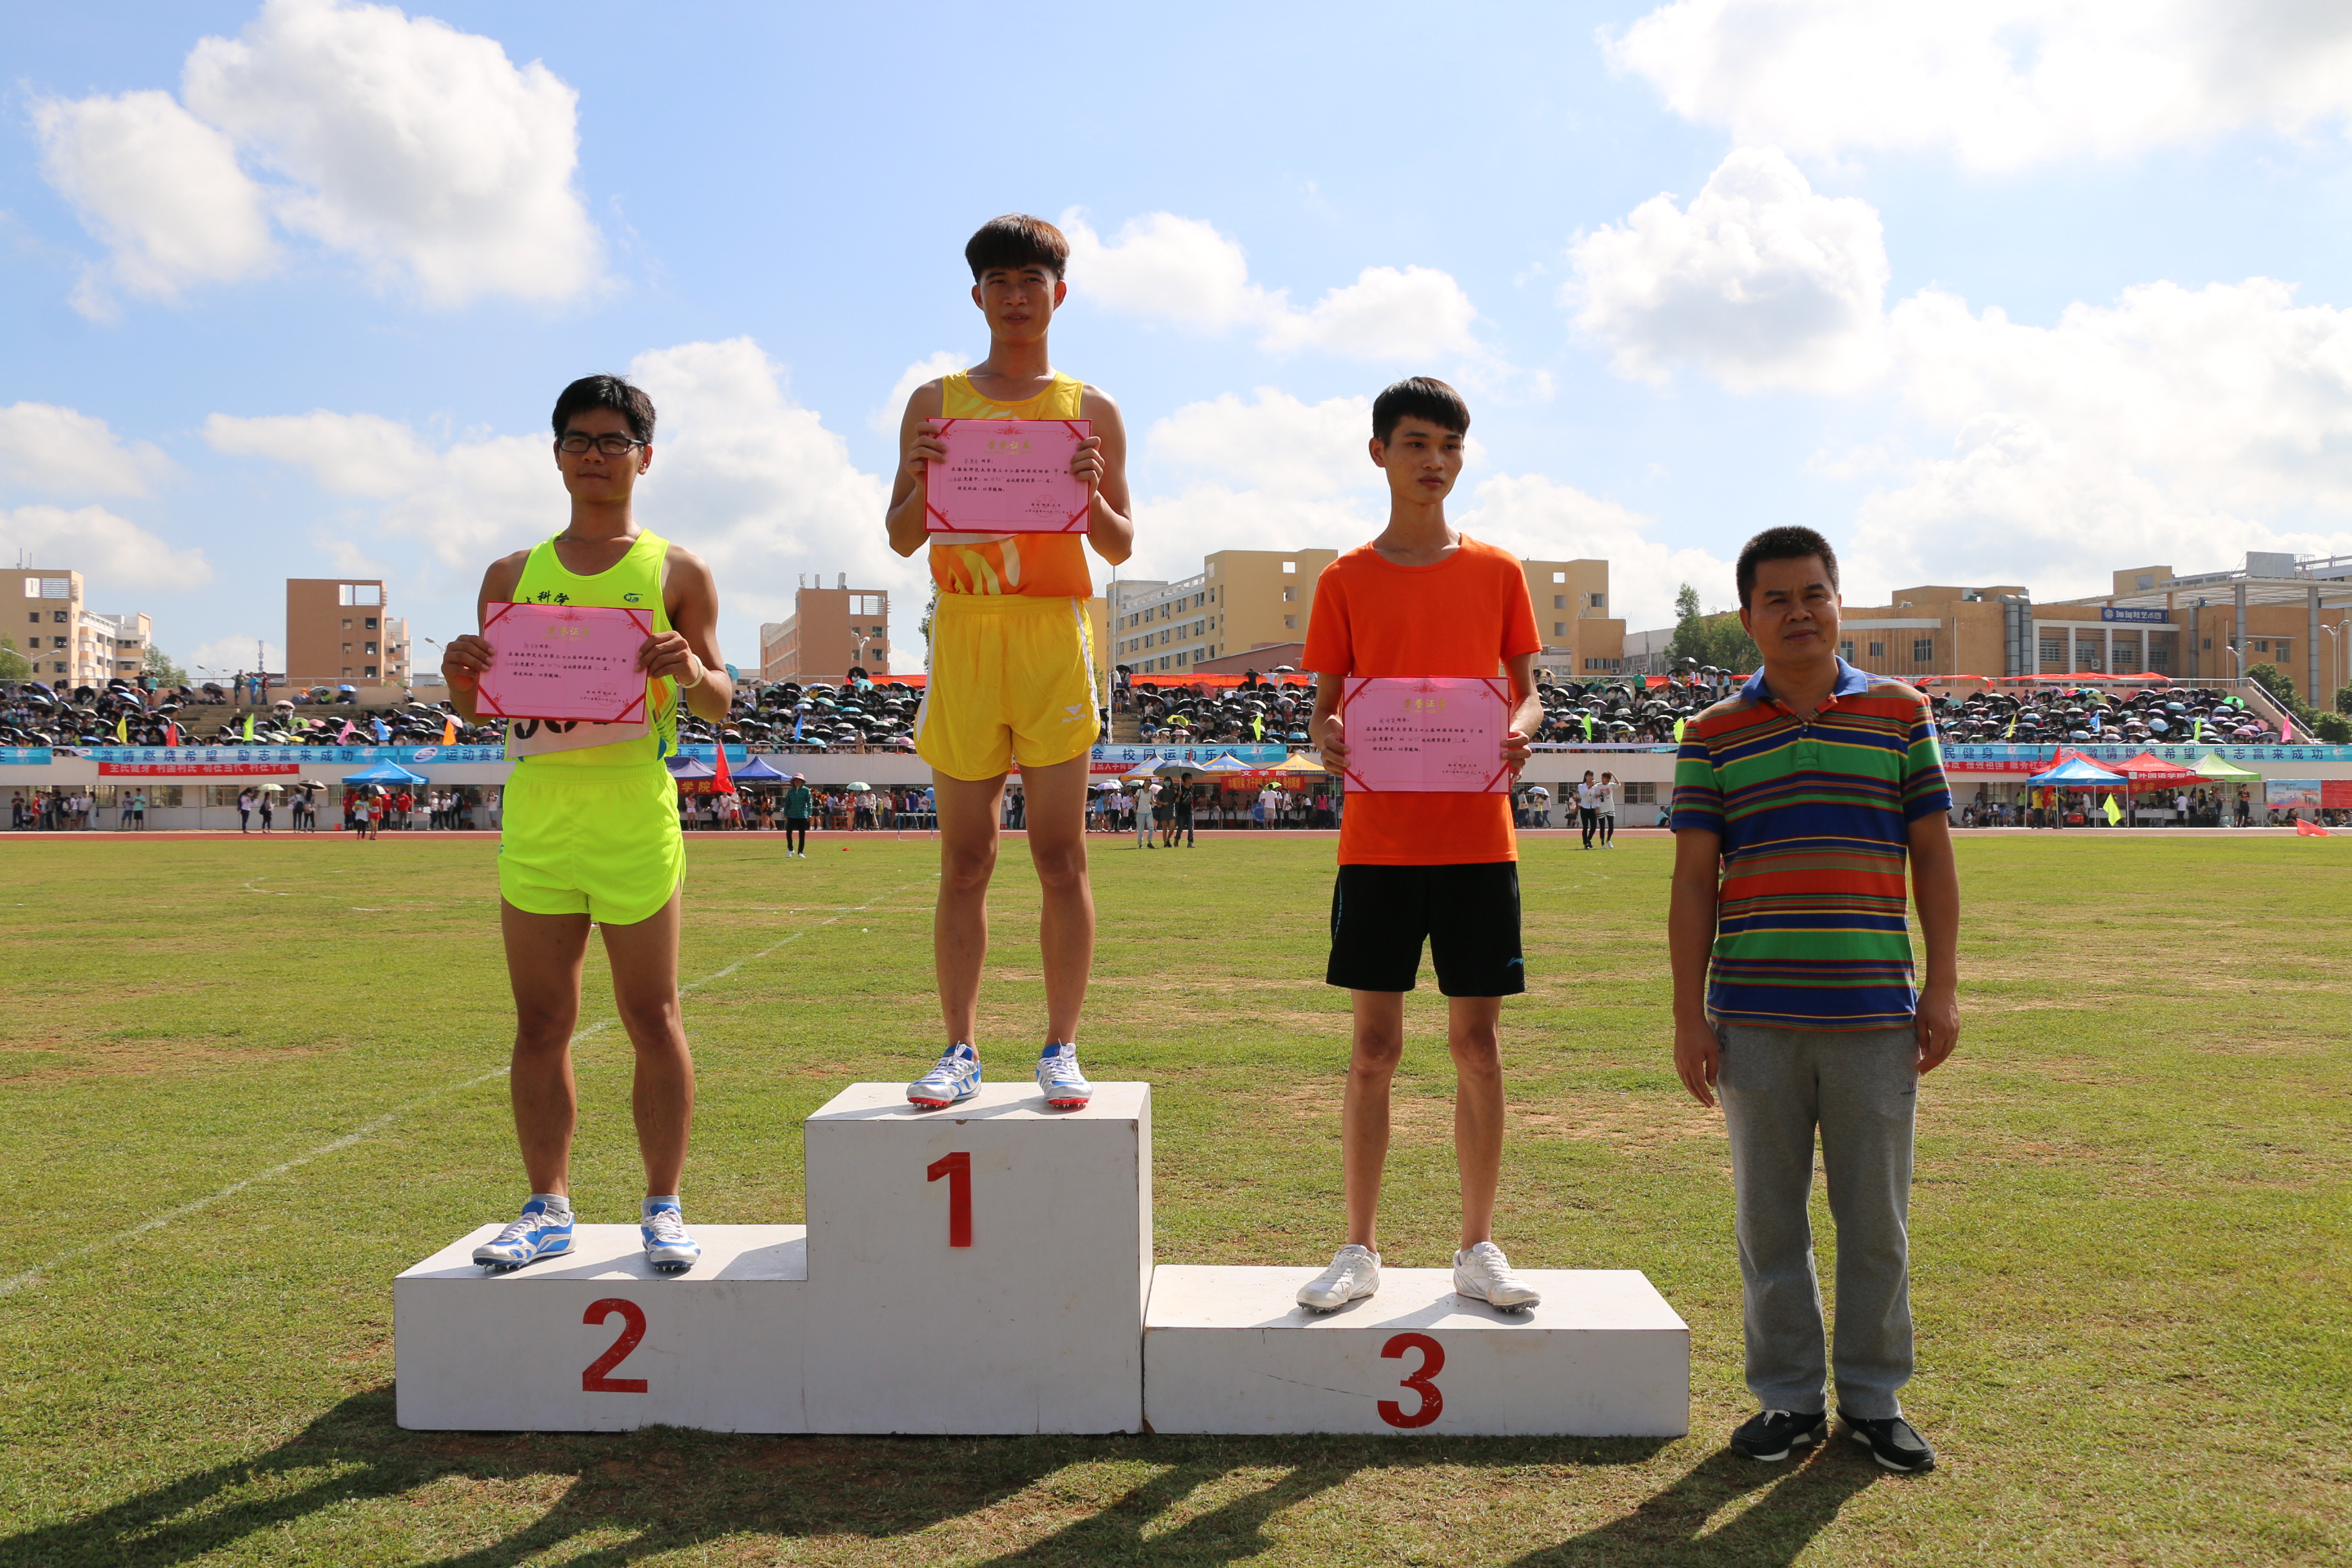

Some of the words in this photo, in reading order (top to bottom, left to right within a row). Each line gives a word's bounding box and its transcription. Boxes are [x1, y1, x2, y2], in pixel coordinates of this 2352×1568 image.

[101, 749, 218, 763] 激情燃烧希望
[237, 749, 354, 762] 励志赢来成功
[446, 749, 505, 761] 运动赛场
[1122, 748, 1238, 761] 校园运动乐章
[1944, 747, 1994, 760] 民健身
[2086, 747, 2195, 760] 激情燃烧希望
[2214, 747, 2323, 760] 励志赢来成功
[681, 781, 711, 792] 学院
[928, 1152, 972, 1247] 1
[583, 1299, 647, 1393] 2
[1378, 1333, 1445, 1427] 3
